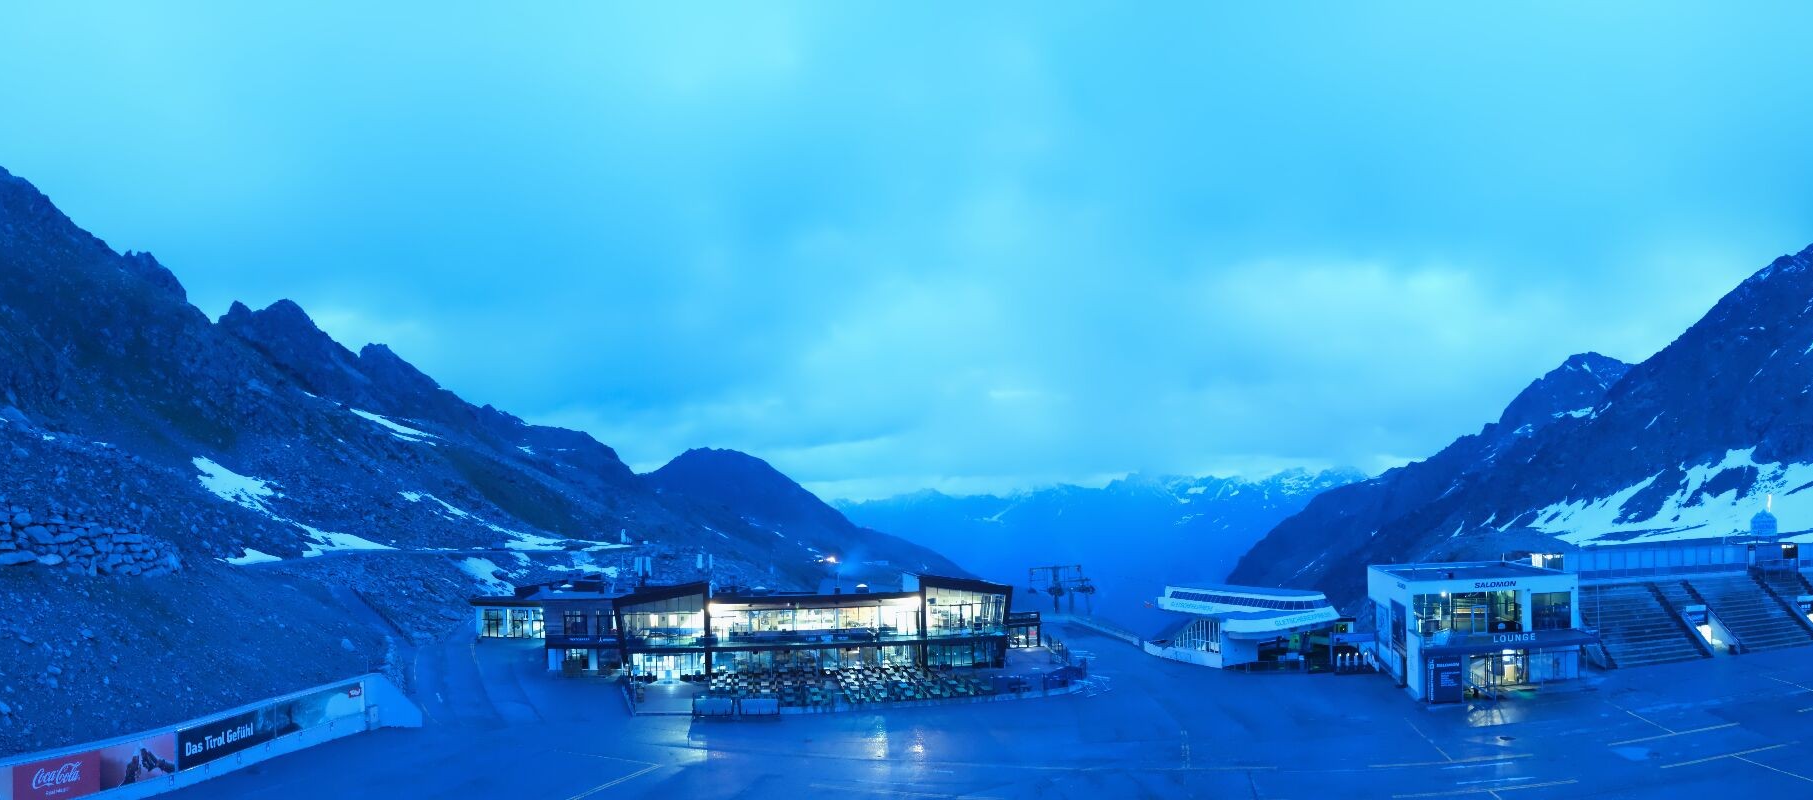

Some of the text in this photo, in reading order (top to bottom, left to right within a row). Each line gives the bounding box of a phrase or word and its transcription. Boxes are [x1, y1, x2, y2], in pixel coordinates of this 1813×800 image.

[1474, 580, 1517, 589] SALOMON
[1493, 632, 1536, 643] LOUNGE
[185, 723, 254, 757] Das Tirol Gefühl
